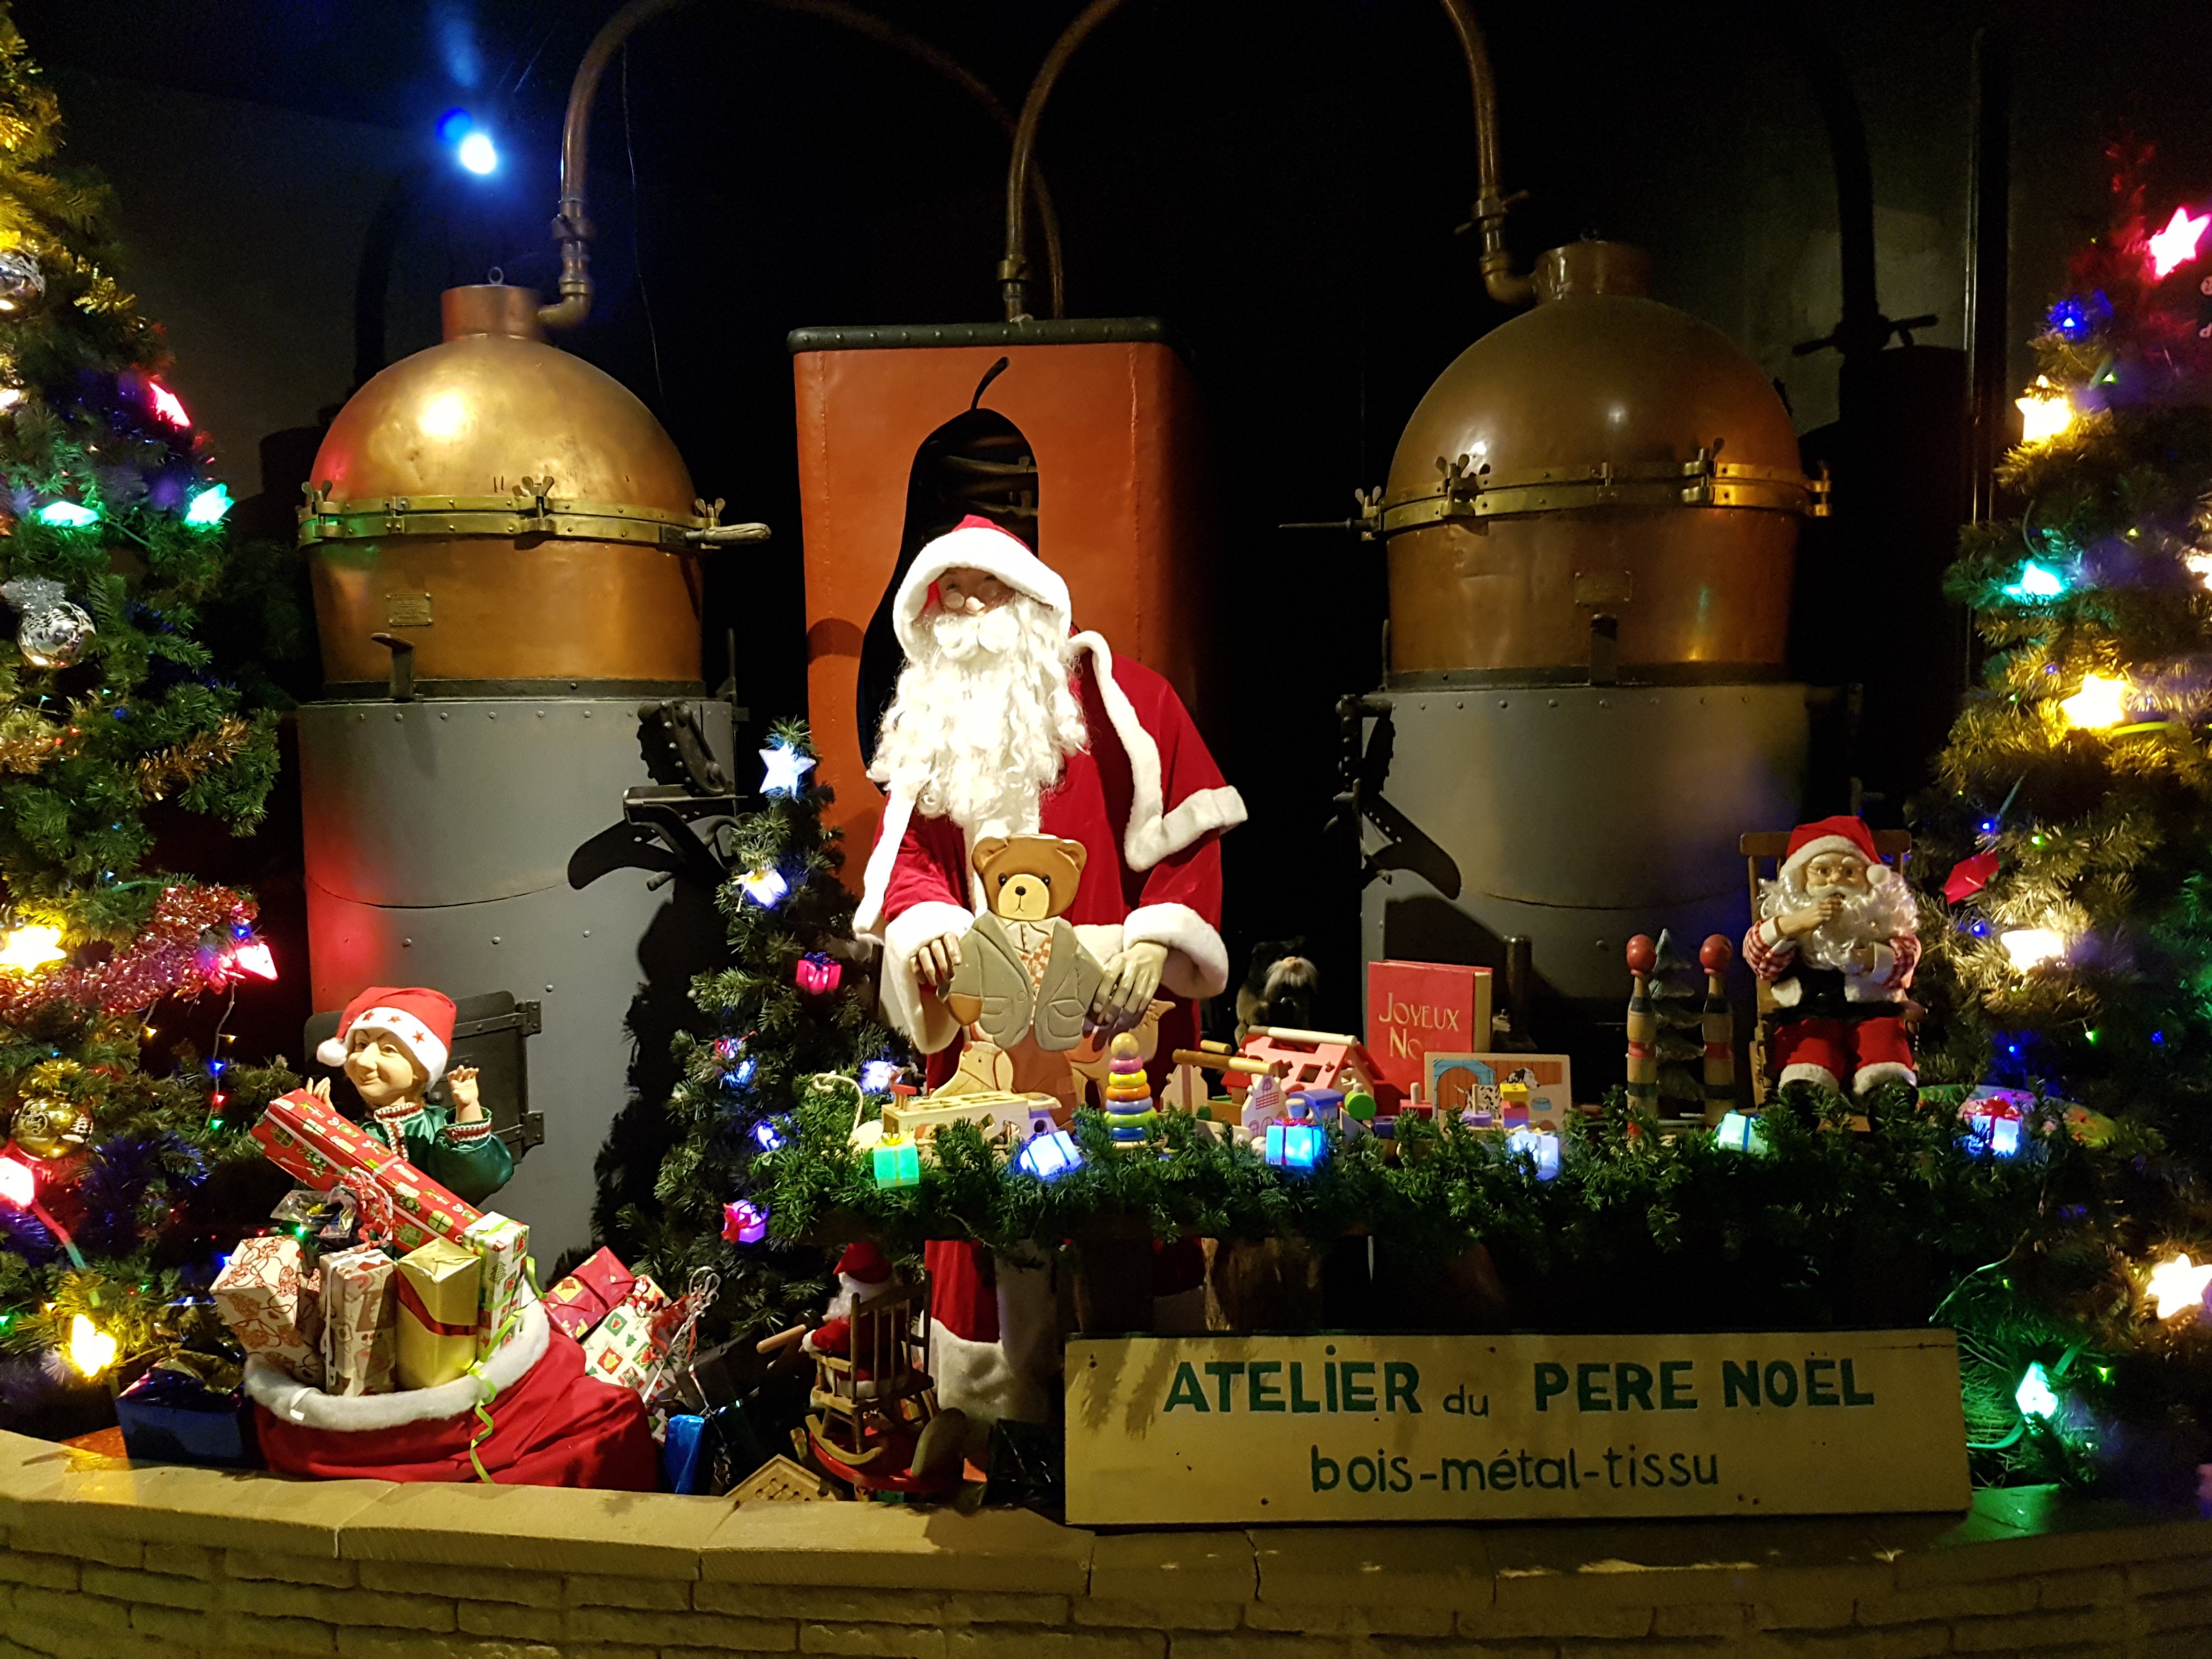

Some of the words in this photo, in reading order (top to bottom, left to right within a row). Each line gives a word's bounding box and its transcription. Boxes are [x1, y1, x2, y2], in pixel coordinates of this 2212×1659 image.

[1379, 992, 1459, 1032] JOYEUX
[1443, 1384, 1490, 1418] du
[1534, 1361, 1699, 1412] PERE
